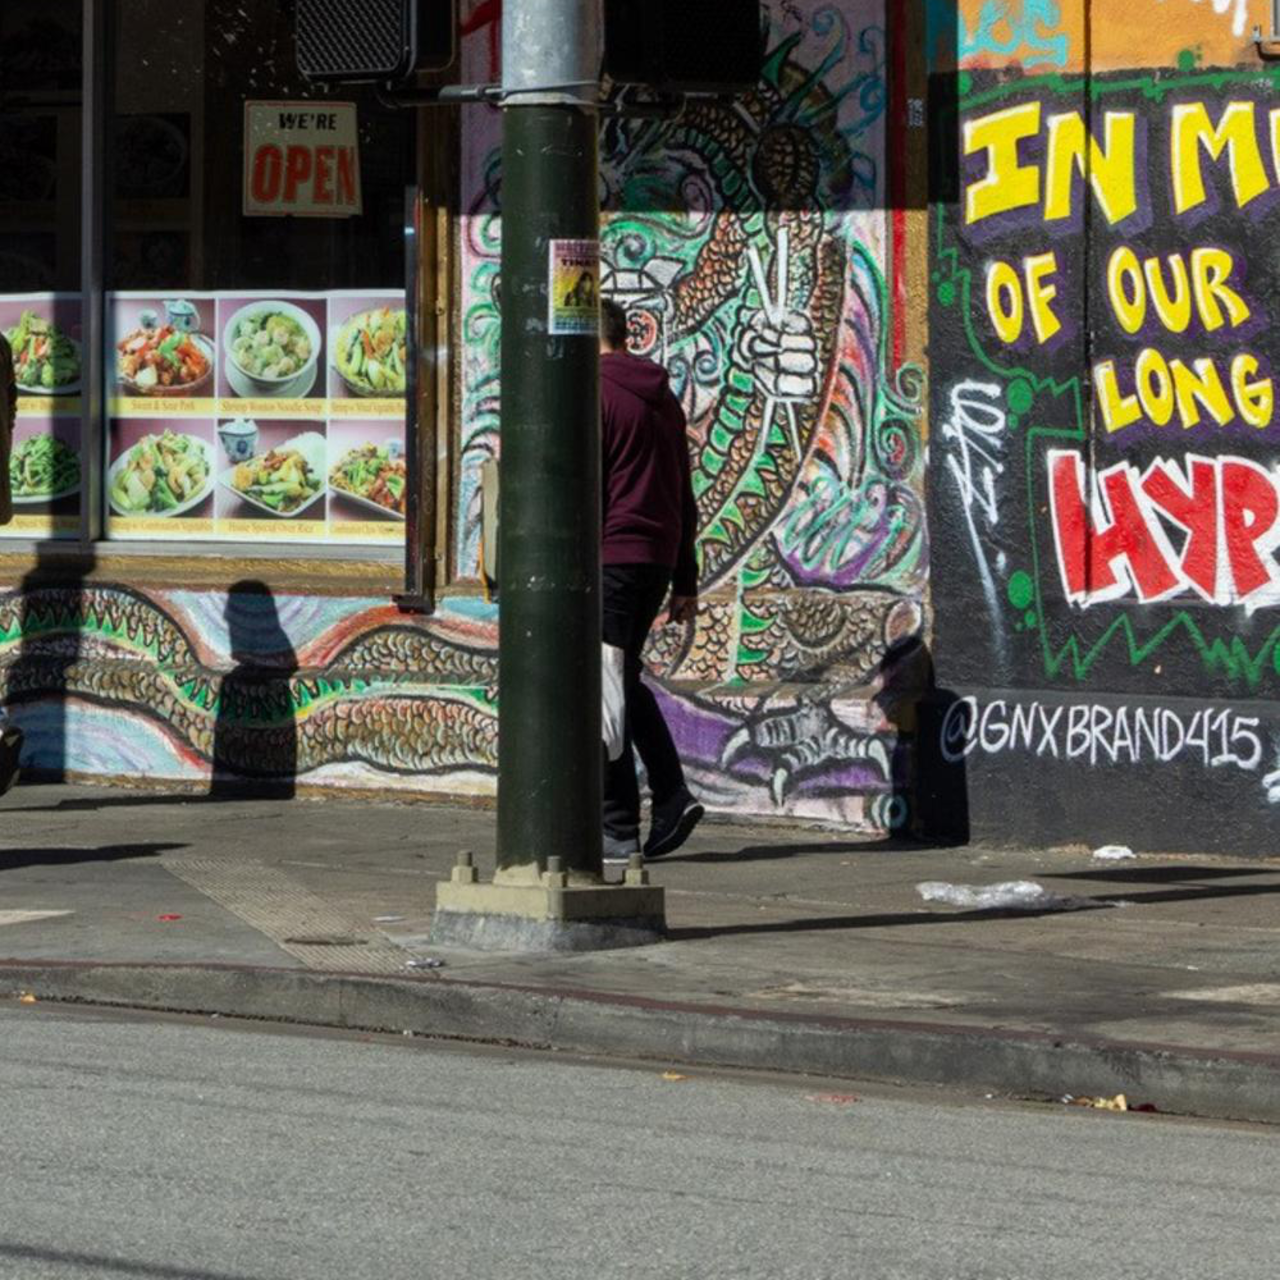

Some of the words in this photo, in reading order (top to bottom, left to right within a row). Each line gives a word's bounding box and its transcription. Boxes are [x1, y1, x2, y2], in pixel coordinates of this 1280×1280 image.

[278, 111, 337, 131] WE'RE
[250, 143, 360, 206] OPEN
[963, 100, 1137, 225] IN
[1170, 100, 1280, 216] M
[986, 252, 1062, 344] OF
[1107, 245, 1251, 334] OUR
[1093, 348, 1274, 434] LONG
[941, 696, 1262, 769] @GNXBRAND415
